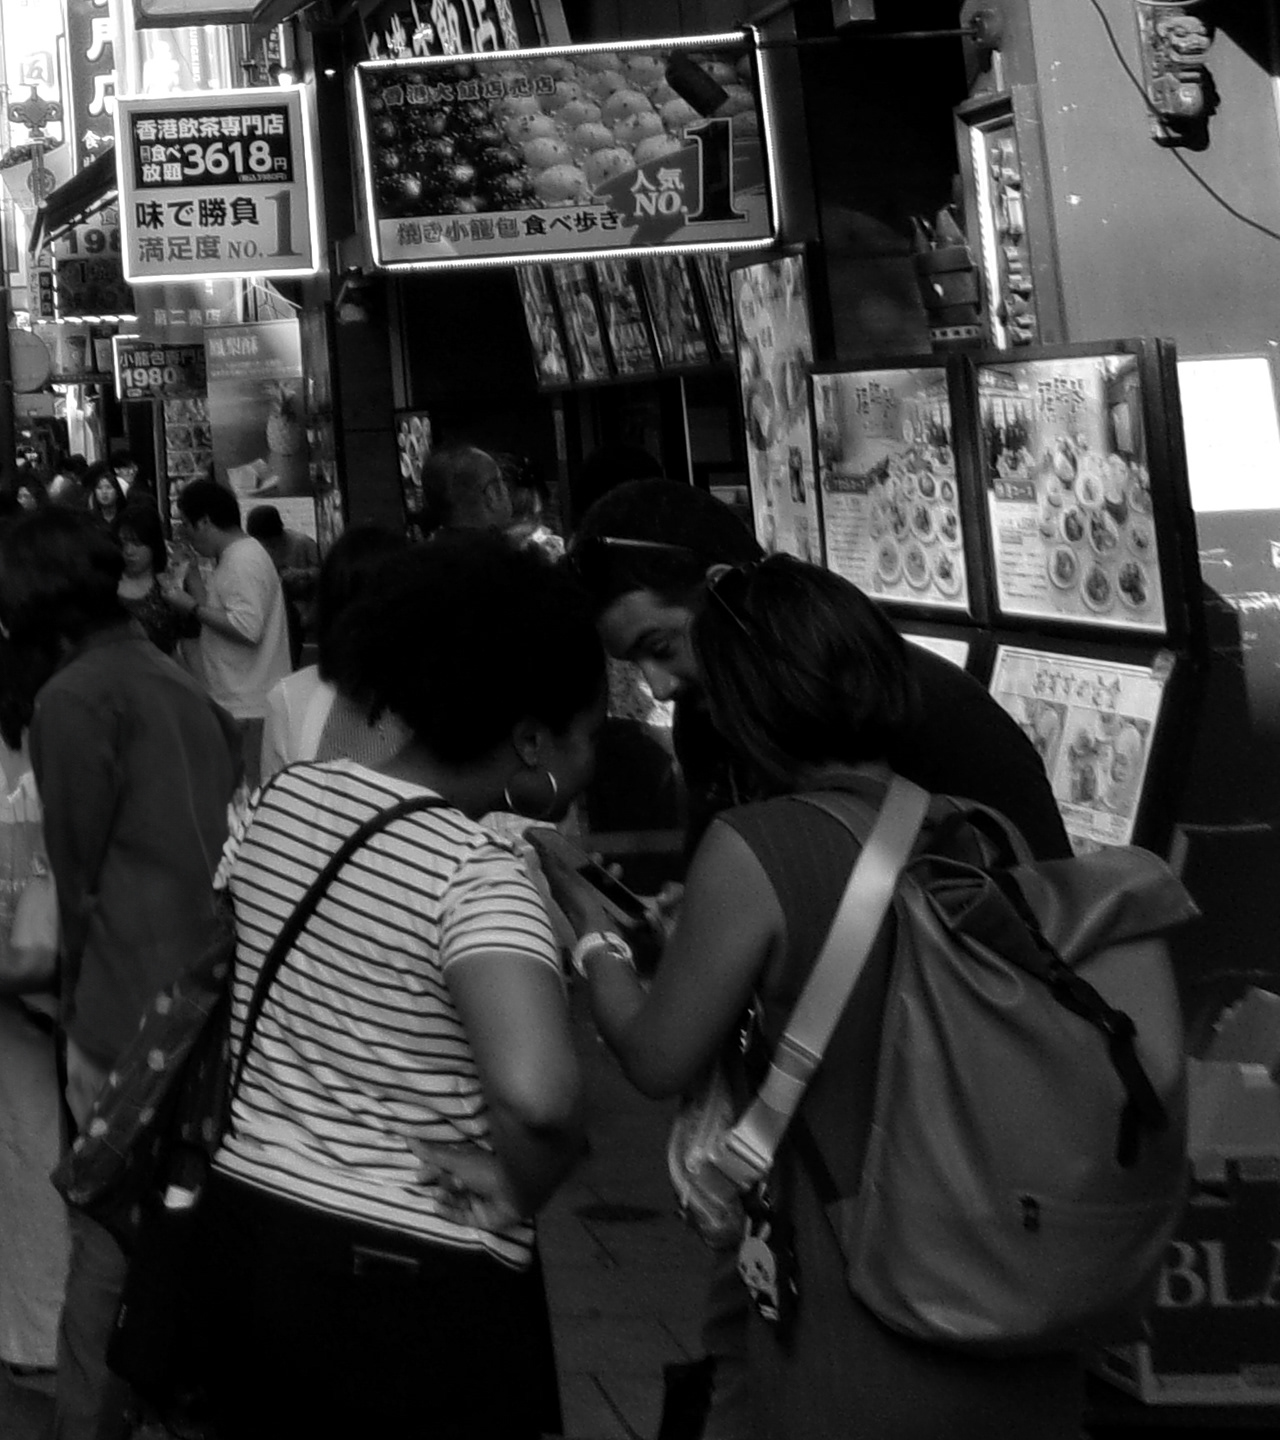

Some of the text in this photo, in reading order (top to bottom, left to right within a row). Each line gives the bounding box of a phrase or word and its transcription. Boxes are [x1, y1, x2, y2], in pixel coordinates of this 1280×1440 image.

[136, 114, 285, 141] 香港飲茶専門店
[151, 144, 181, 162] 食べ
[183, 140, 272, 175] 3618
[142, 162, 183, 182] 放題
[632, 167, 684, 192] 人気
[135, 197, 259, 229] 味で勝負
[634, 193, 689, 215] NO.
[397, 210, 620, 247] 焼き小籠包 食べ歩き
[138, 235, 264, 262] 満足度 NO.
[1156, 1240, 1280, 1307] BL
